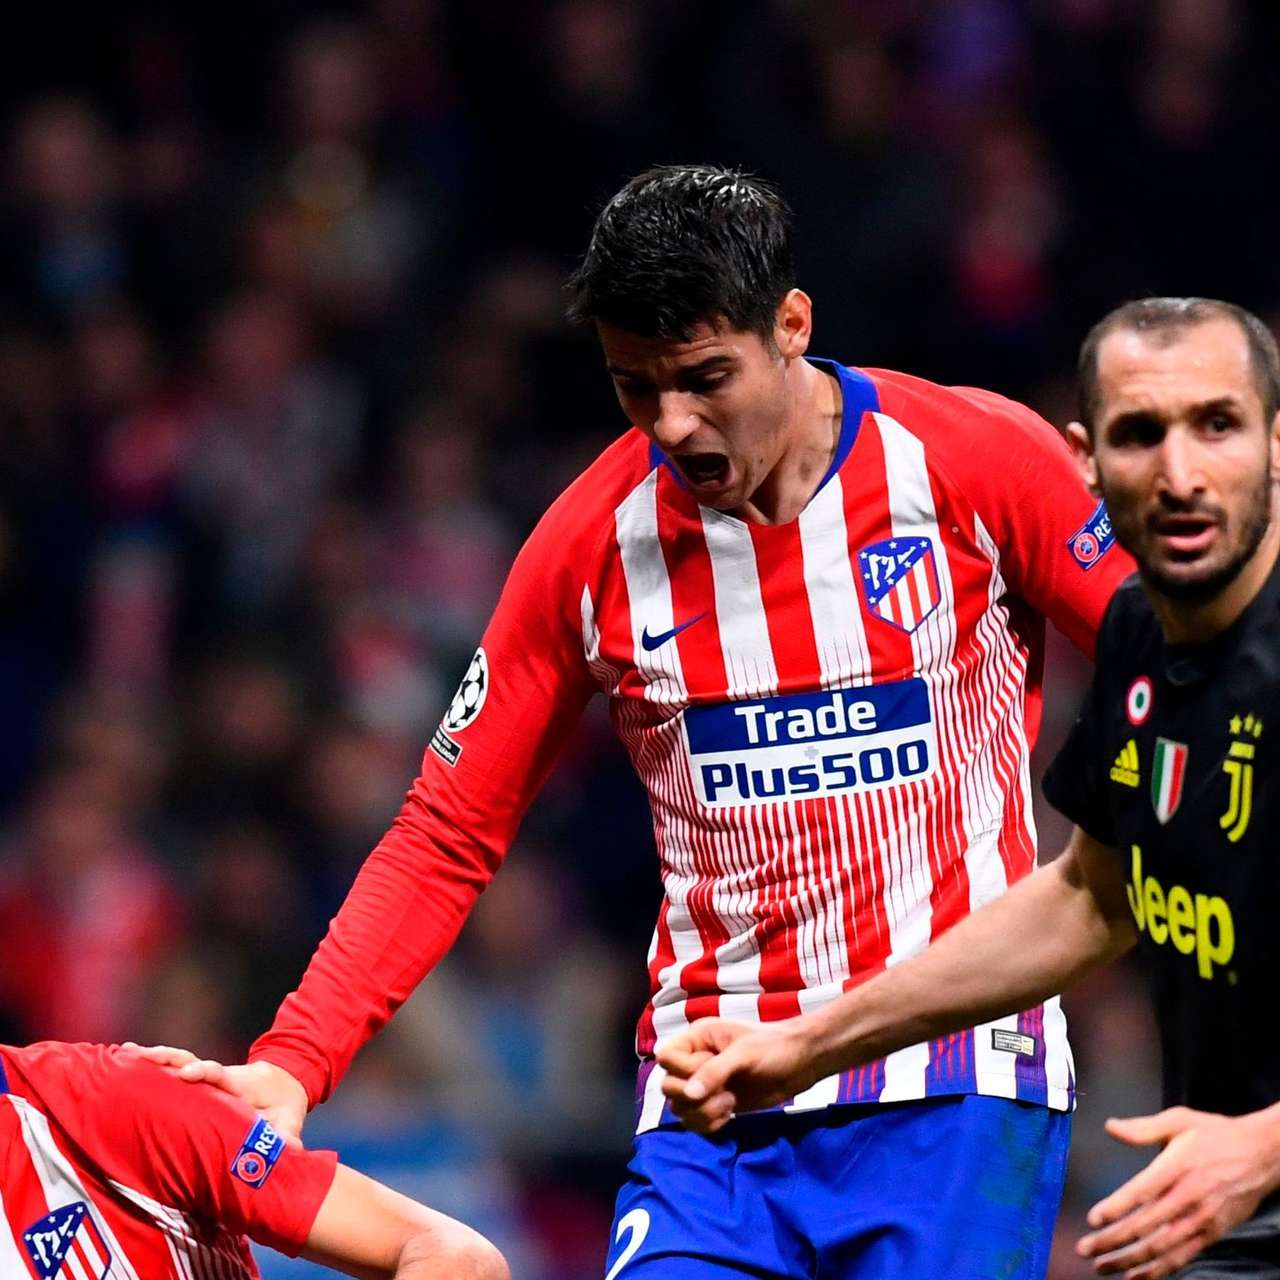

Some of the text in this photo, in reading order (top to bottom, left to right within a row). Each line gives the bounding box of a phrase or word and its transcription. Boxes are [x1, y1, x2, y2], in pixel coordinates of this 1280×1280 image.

[734, 692, 878, 744] Trade
[701, 739, 930, 802] Plus500
[1125, 843, 1237, 980] Jeep
